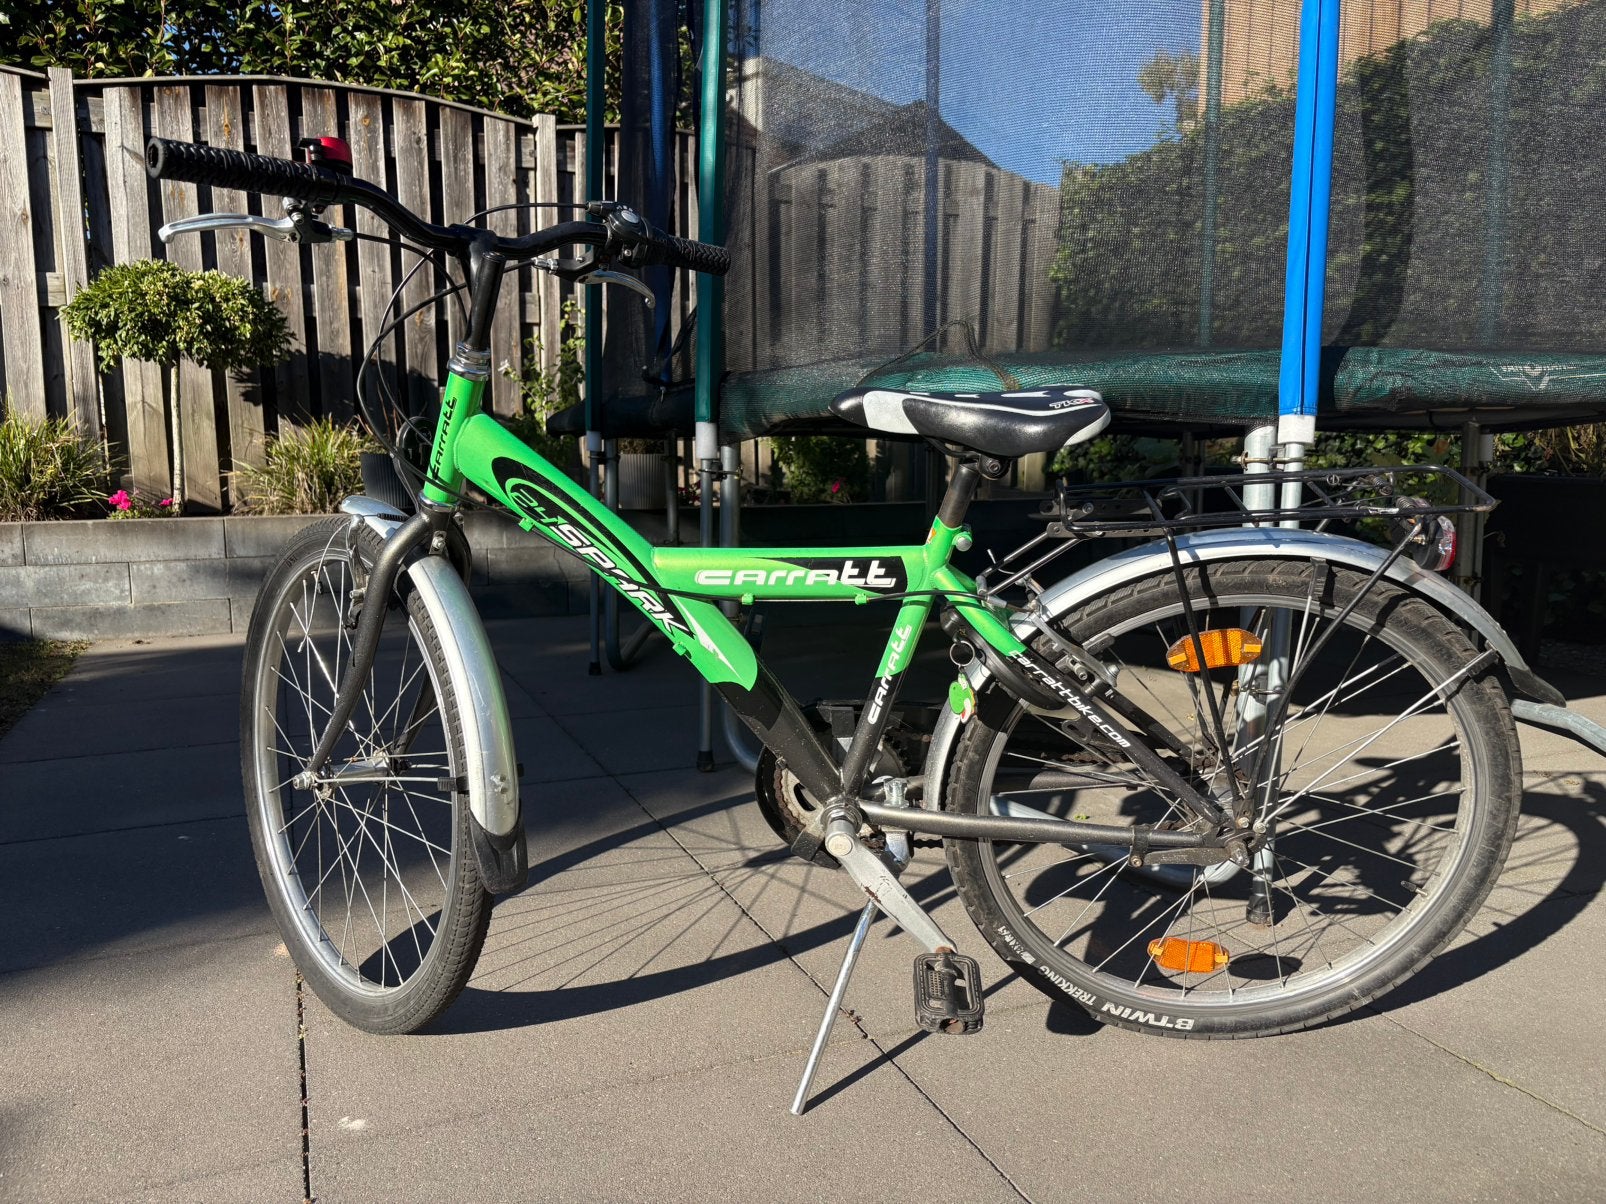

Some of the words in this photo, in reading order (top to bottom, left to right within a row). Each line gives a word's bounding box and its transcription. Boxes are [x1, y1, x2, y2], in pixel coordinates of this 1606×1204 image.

[549, 523, 694, 638] SPARK
[1009, 650, 1131, 748] carrattbike.com
[1038, 965, 1097, 1006] TREKKING
